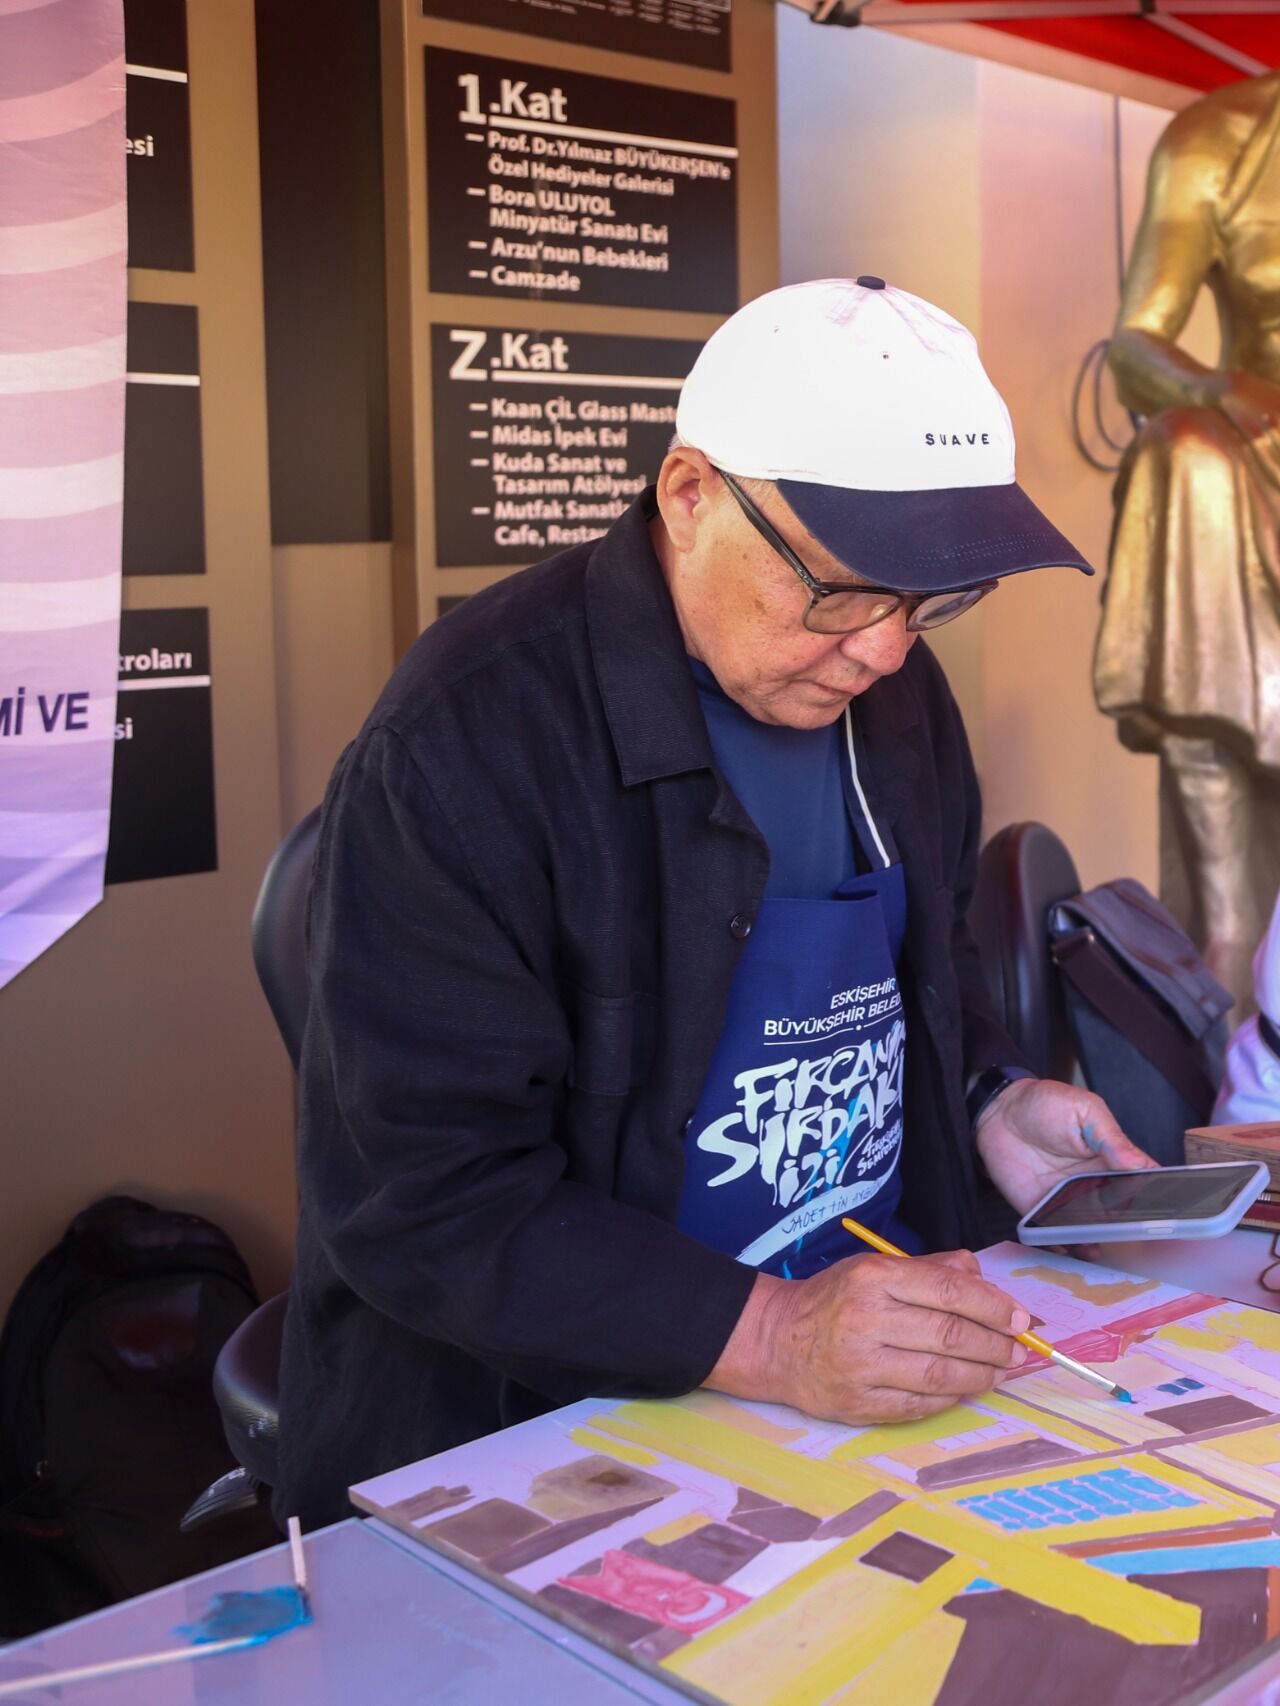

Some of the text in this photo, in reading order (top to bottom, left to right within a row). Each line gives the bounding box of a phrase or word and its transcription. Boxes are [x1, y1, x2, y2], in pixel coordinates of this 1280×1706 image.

[458, 73, 568, 124] 1.Kat
[488, 131, 530, 153] Prof.
[488, 153, 675, 196] Özel Hediyeler Galerisi
[489, 184, 616, 217] Bora ULUYOL
[489, 208, 669, 244] Minyatür Sanatı Evi
[491, 238, 669, 272] Arzu'nun Bebekleri
[491, 266, 580, 291] Camzade
[449, 329, 569, 381] Z.Kat
[492, 398, 541, 419] Kaan
[579, 400, 628, 422] Glass
[630, 402, 677, 423] Mast
[492, 422, 628, 450] Midas İpek Evi
[925, 433, 990, 446] SUAVE
[493, 453, 627, 474] Kuda Sanat ve
[493, 474, 647, 498] Tasarım Atölyesi
[494, 501, 563, 521] Mutfak
[495, 525, 545, 547] Cafe,
[38, 692, 90, 734] VE
[830, 977, 896, 1009] ESKİŞEHİR
[764, 1005, 866, 1036] BÜYÜKŞEHİR
